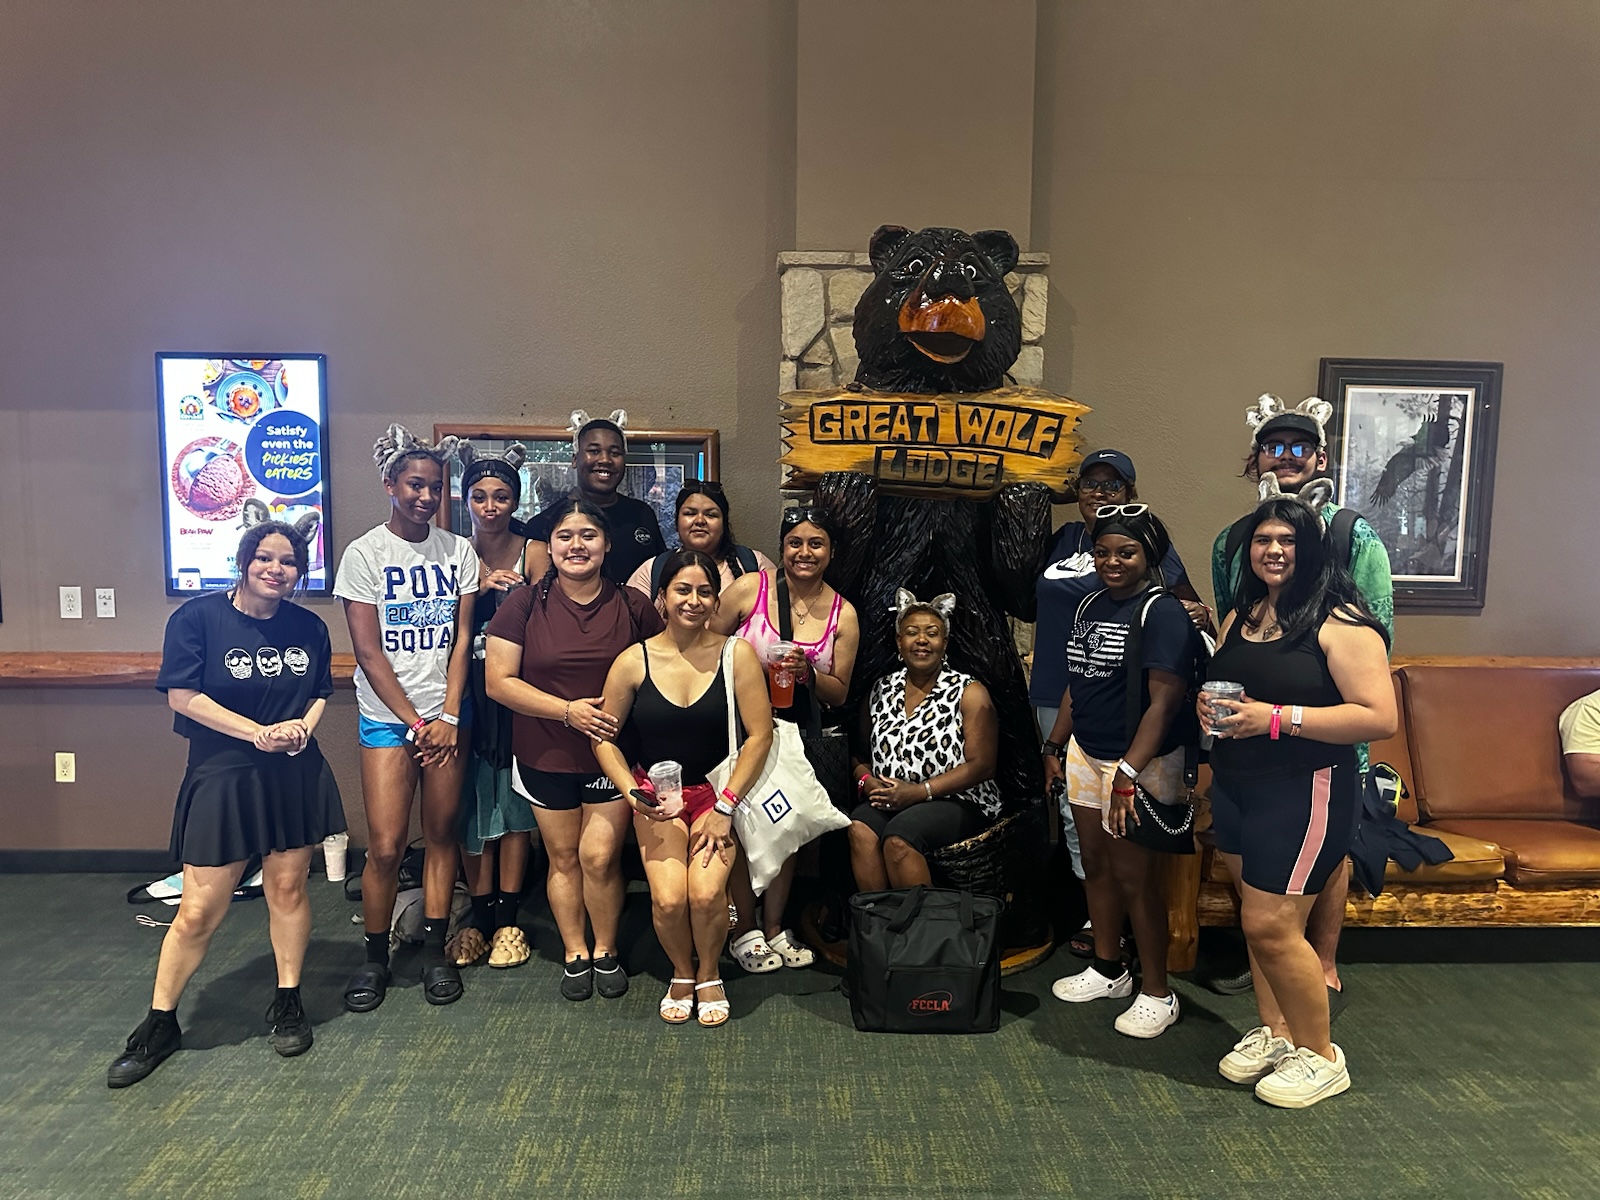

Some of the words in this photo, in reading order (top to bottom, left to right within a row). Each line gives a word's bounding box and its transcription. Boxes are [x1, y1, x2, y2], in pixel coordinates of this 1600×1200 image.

[266, 425, 308, 438] Satisfy
[812, 404, 937, 443] GREAT
[957, 405, 1061, 455] WOLF
[261, 440, 291, 449] even
[293, 439, 314, 449] the
[878, 447, 998, 486] LODGE
[385, 626, 452, 653] SQUA
[912, 1000, 950, 1011] FCCLA
